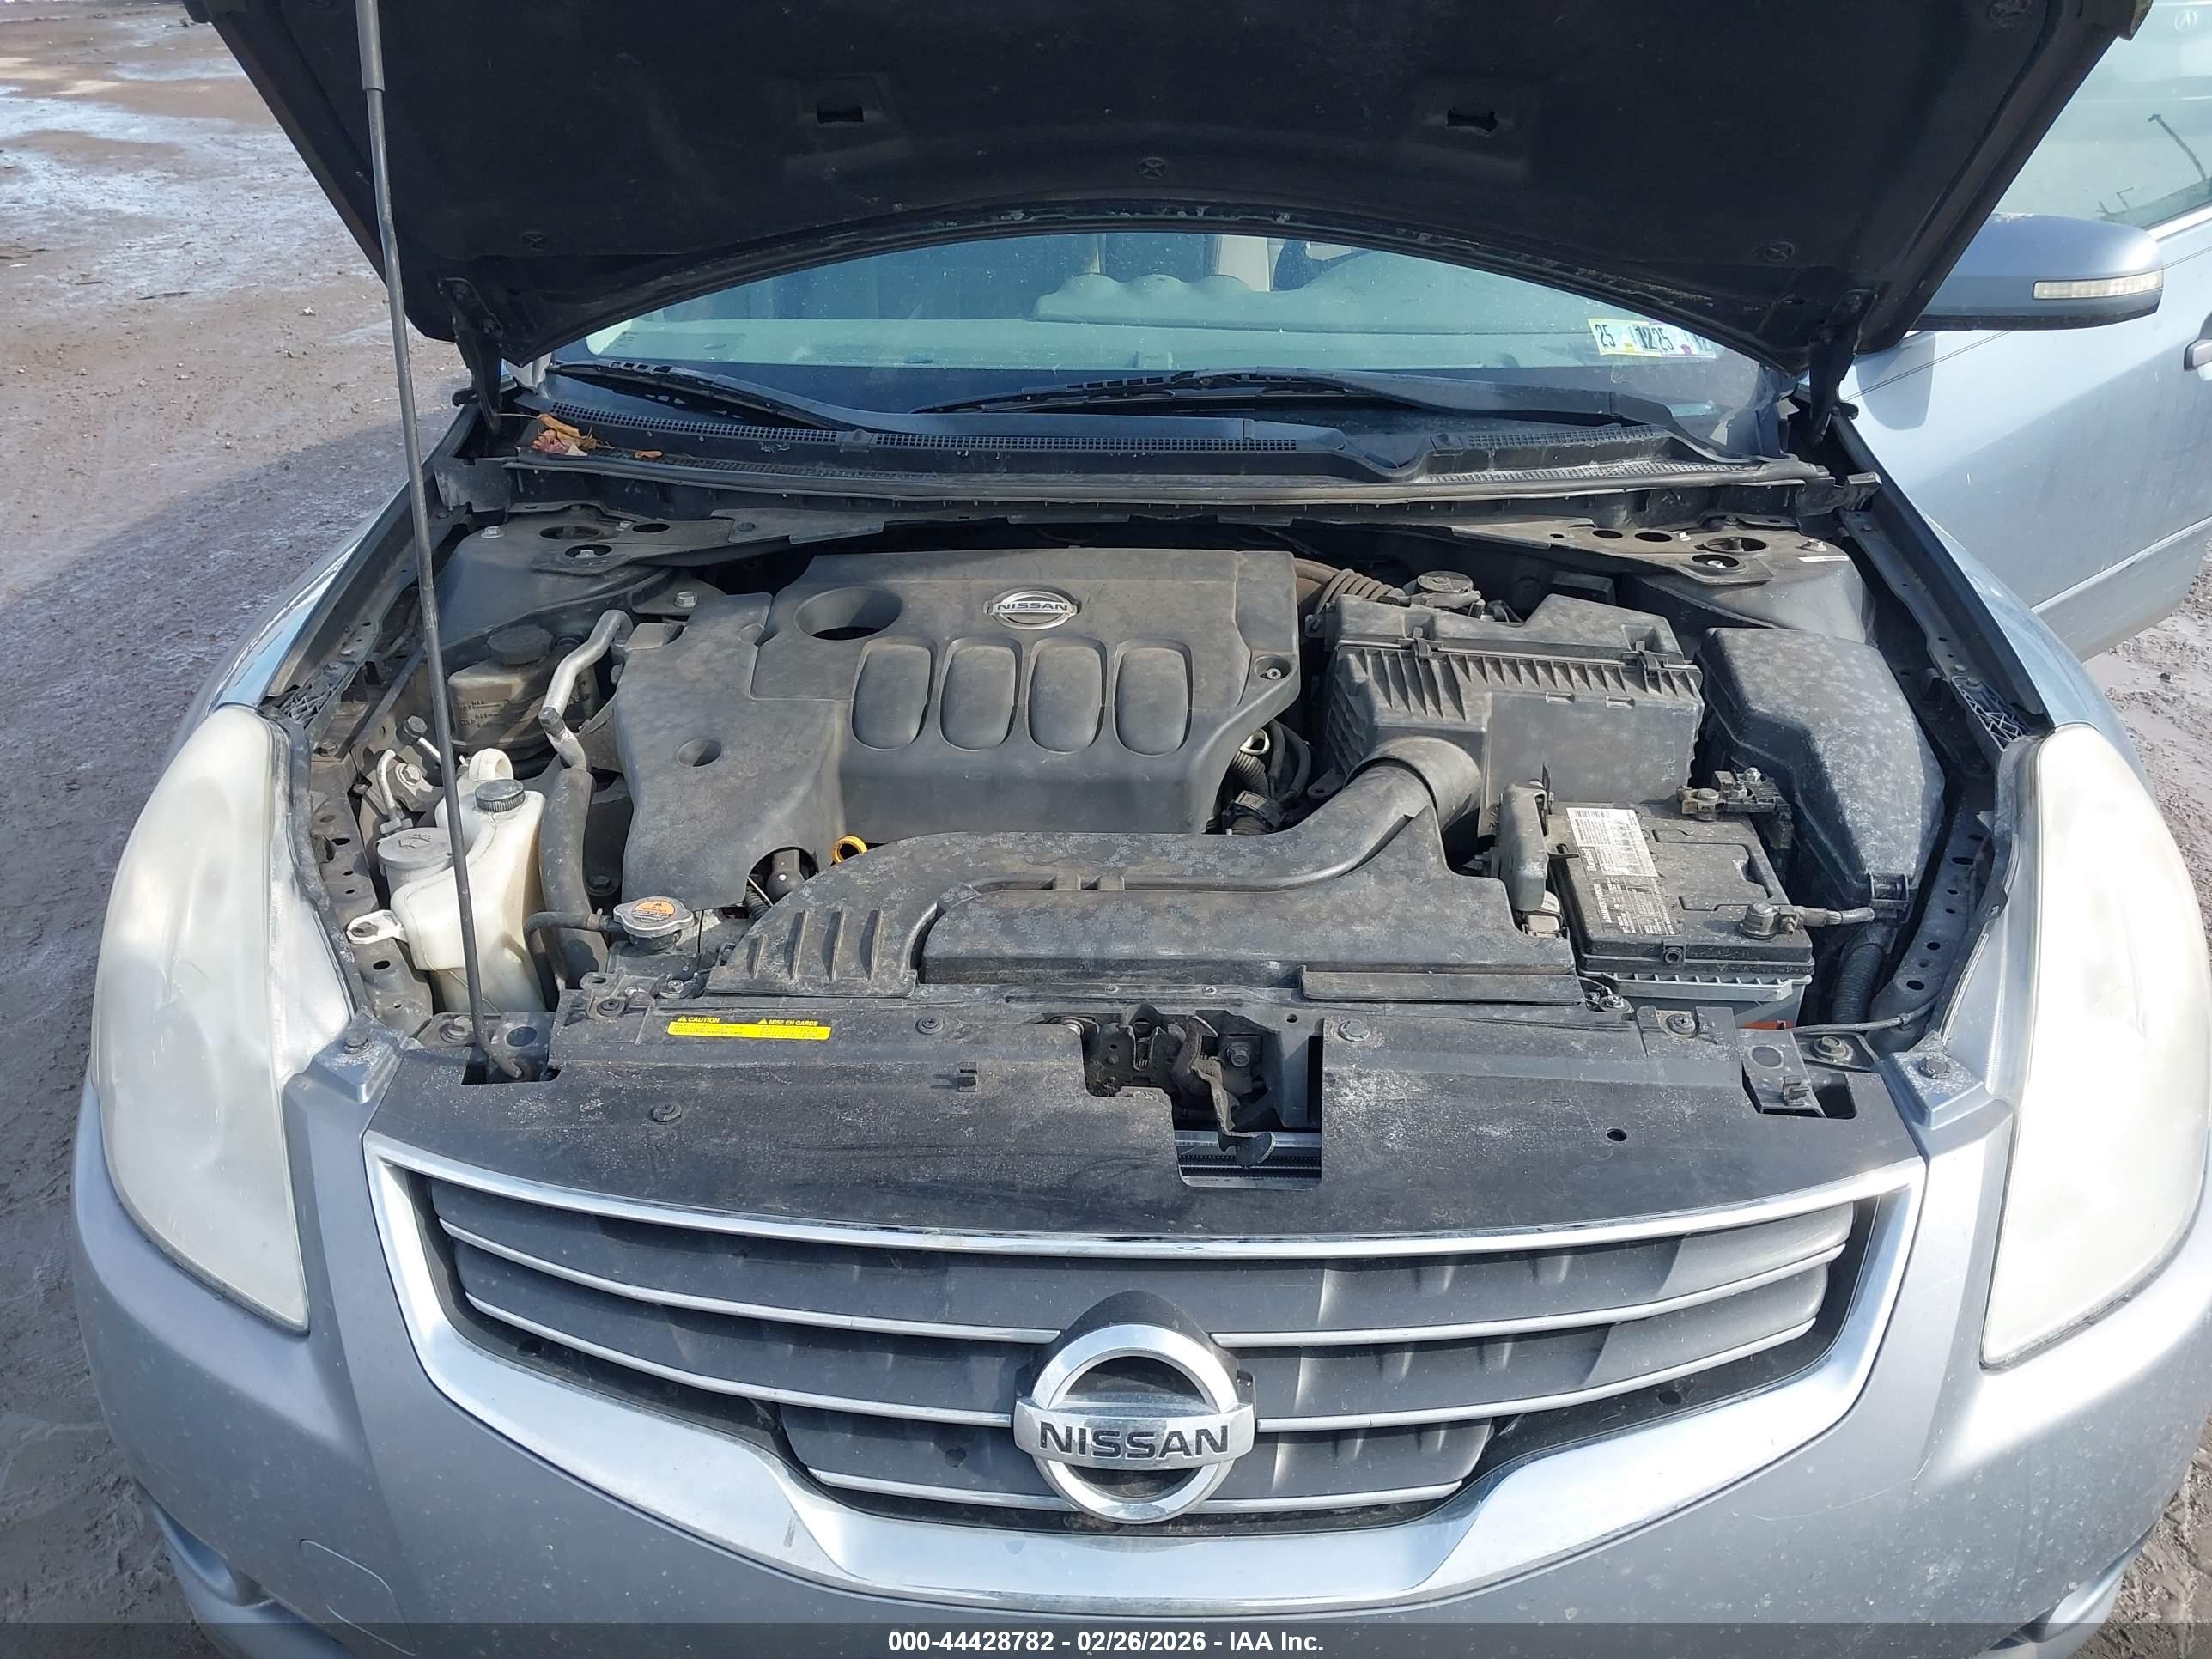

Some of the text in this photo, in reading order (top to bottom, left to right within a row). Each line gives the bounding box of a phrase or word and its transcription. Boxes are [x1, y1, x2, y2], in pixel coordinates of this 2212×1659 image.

[1595, 324, 1658, 349] 25 12
[1652, 327, 1675, 351] 25
[997, 602, 1068, 611] NISSAN
[1039, 1420, 1230, 1460] NISSAN
